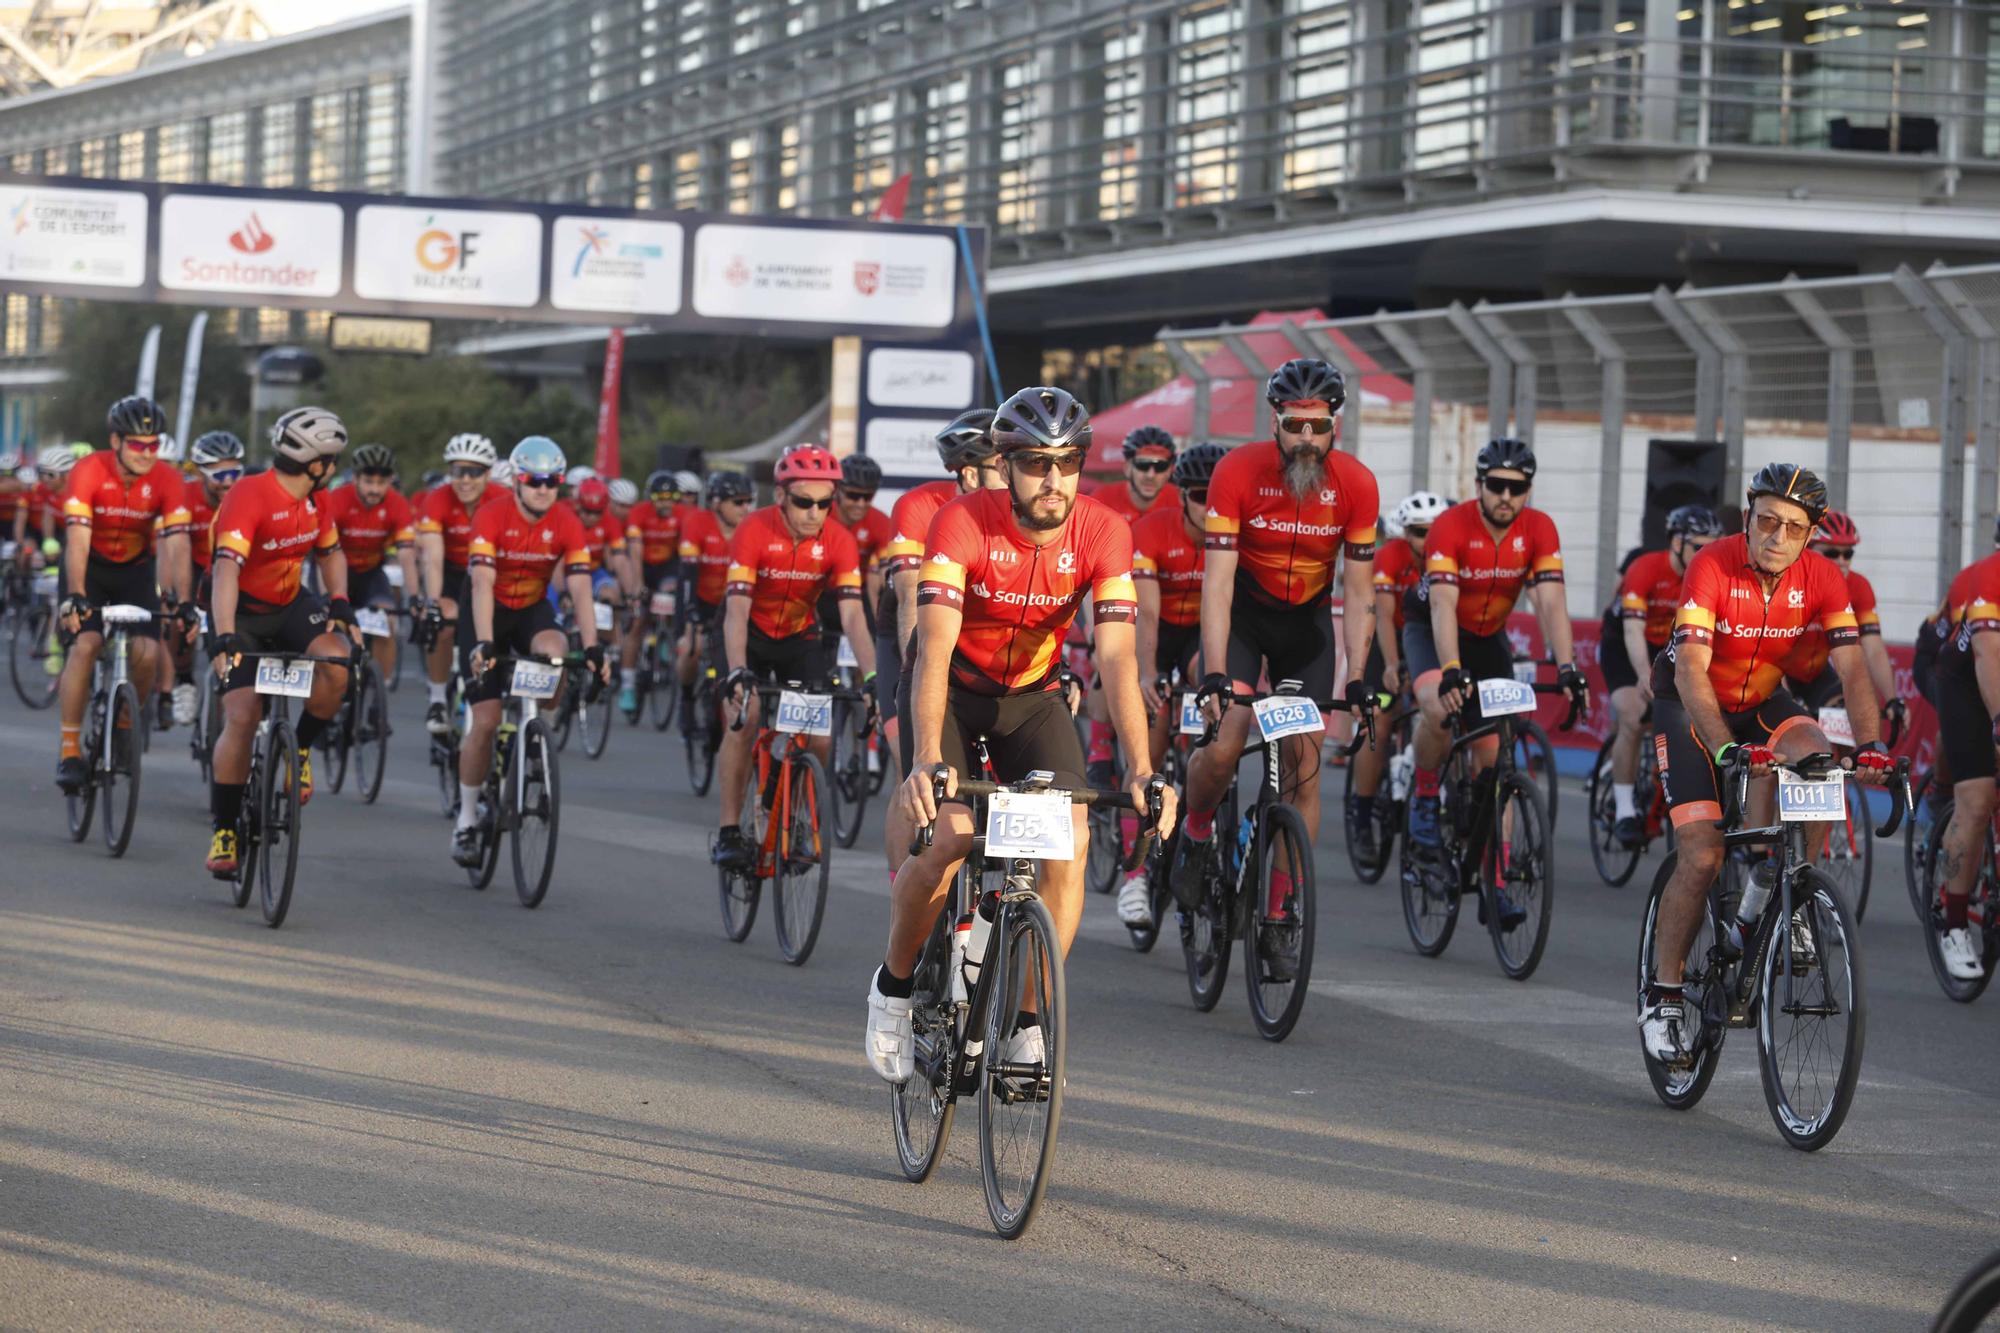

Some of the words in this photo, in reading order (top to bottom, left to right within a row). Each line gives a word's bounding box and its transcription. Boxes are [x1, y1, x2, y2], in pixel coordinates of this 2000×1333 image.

[416, 230, 482, 272] GF
[182, 257, 318, 287] Santander
[1267, 518, 1343, 536] Santander
[1484, 687, 1522, 704] 1550
[1264, 706, 1306, 727] 1626
[1784, 785, 1826, 805] 1011
